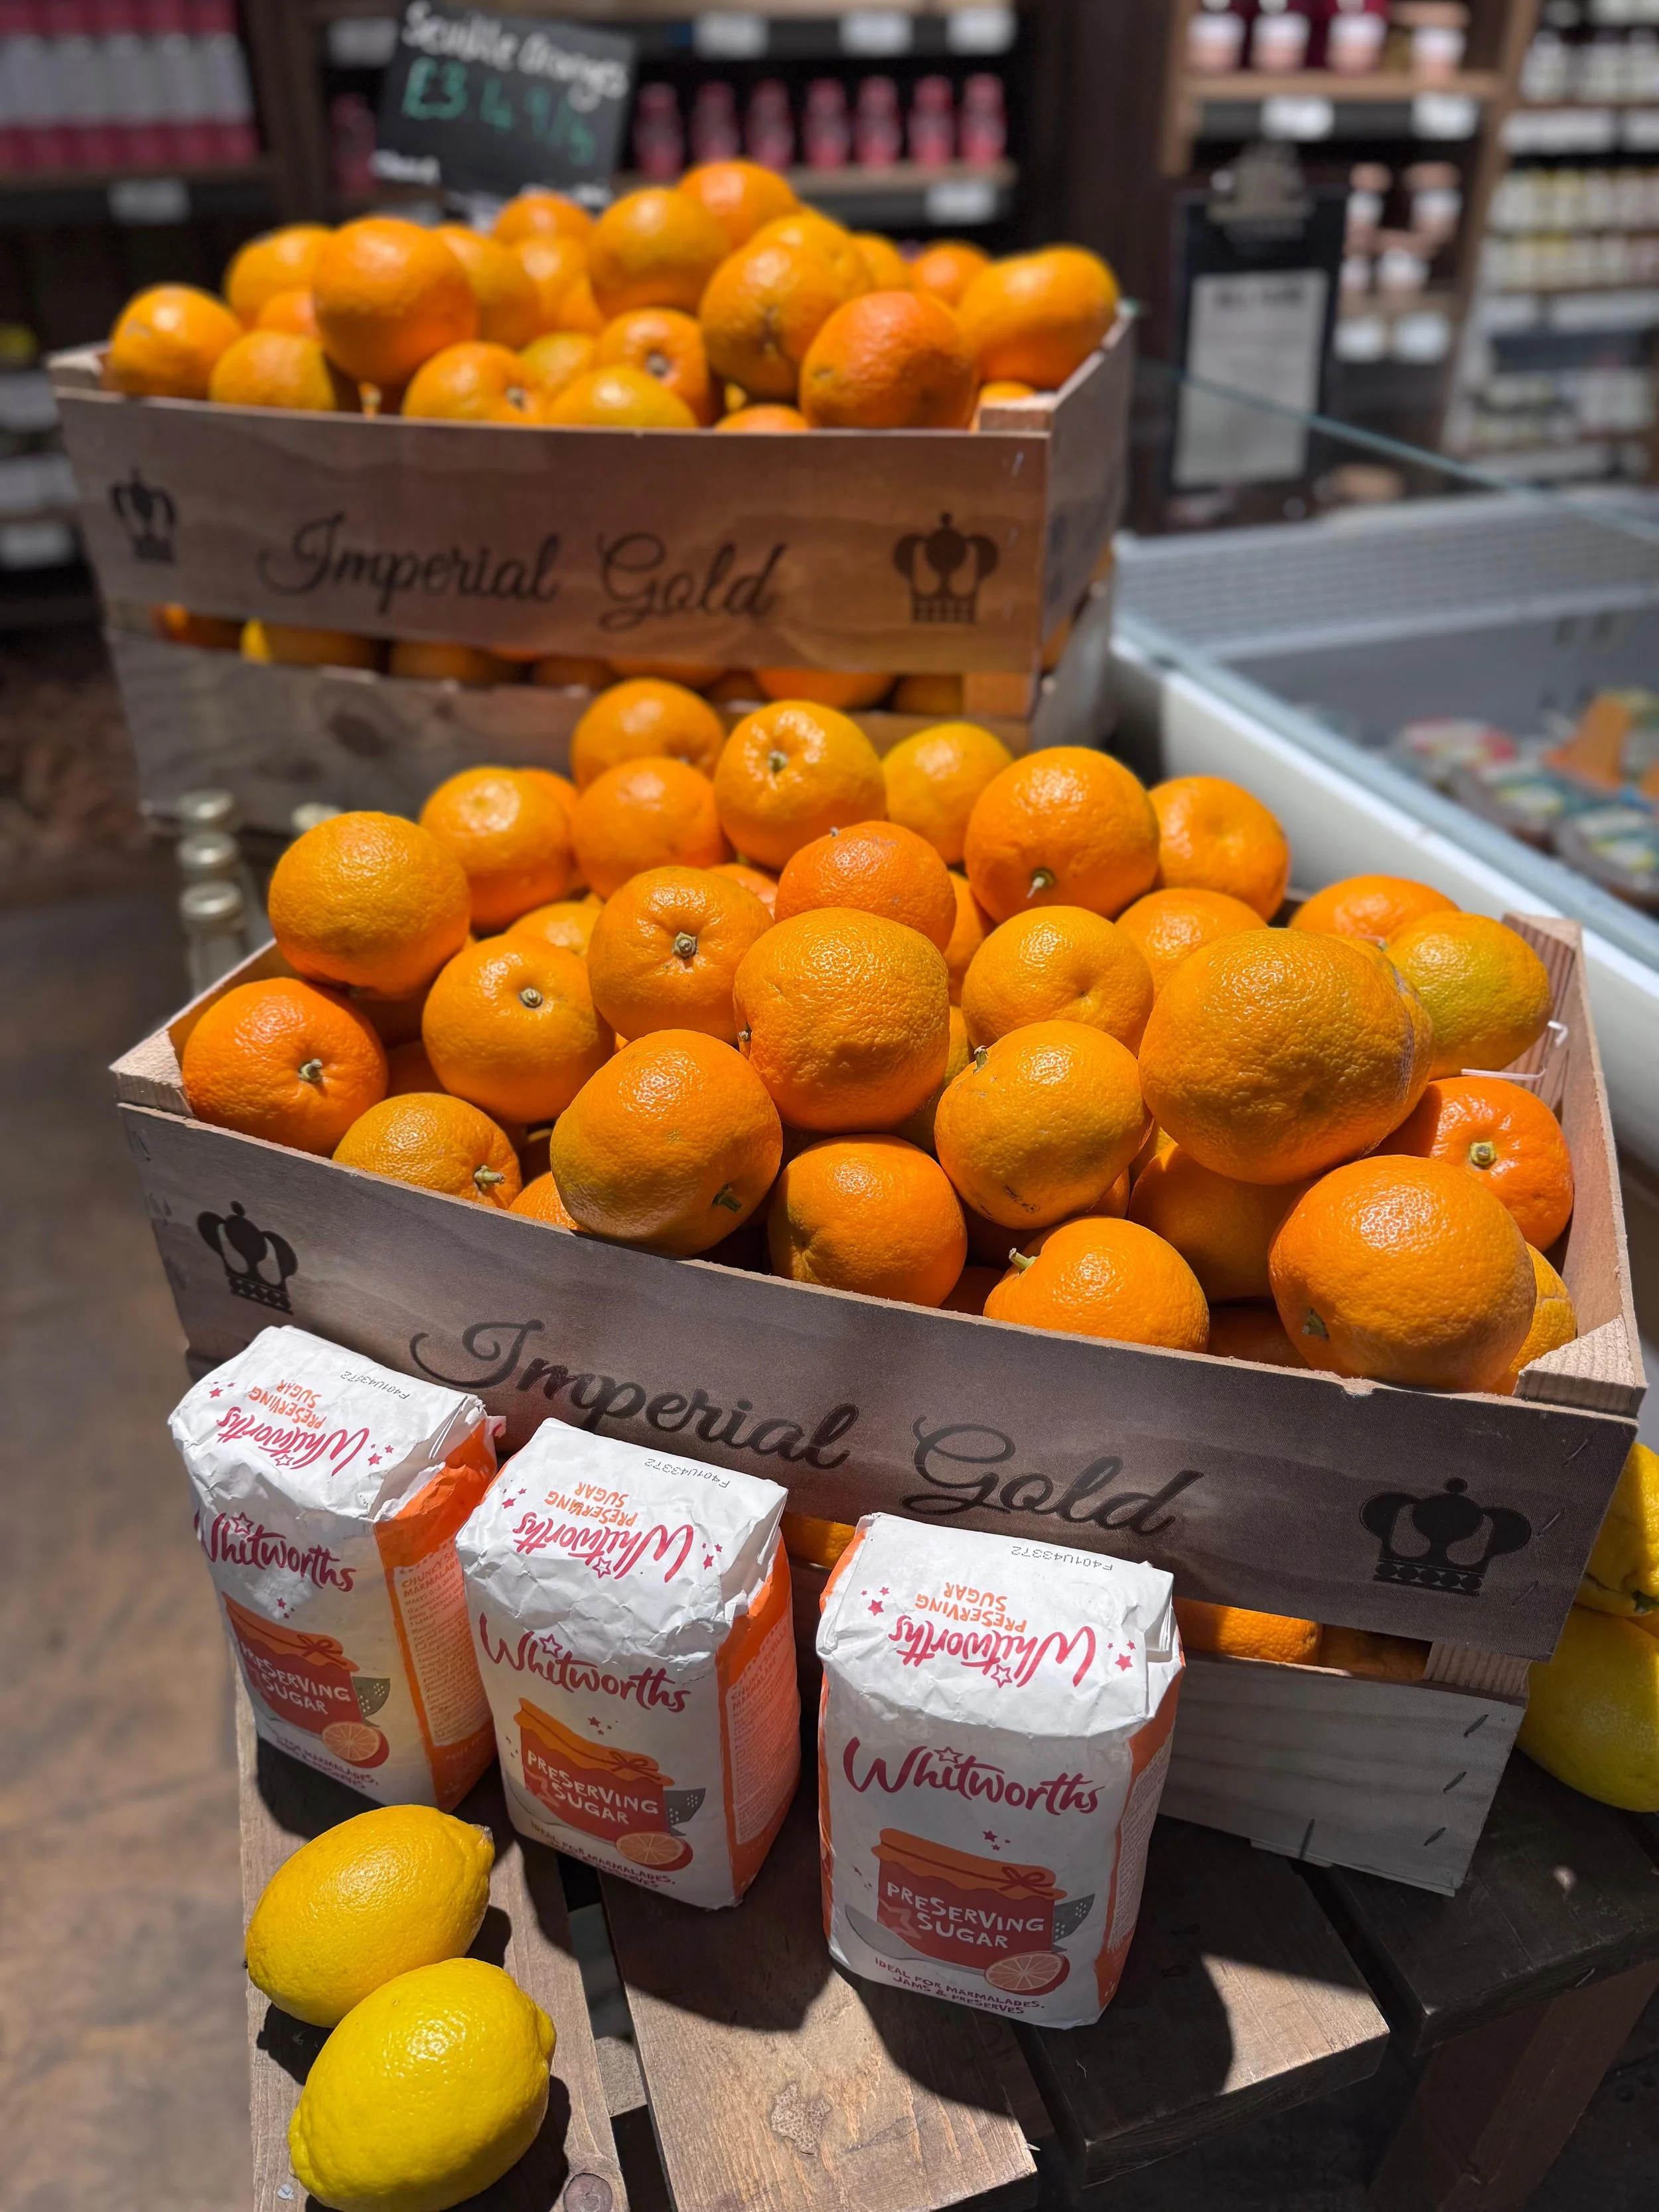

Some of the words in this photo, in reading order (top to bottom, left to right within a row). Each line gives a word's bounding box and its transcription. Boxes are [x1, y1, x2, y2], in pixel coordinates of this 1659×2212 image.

[255, 510, 562, 616] Imperial
[595, 530, 788, 632] Gold
[248, 1386, 327, 1429] PRESERVING
[277, 1379, 322, 1407] SUGAR
[216, 1406, 370, 1476] Whitworths
[409, 1319, 859, 1471] Imperial
[901, 1416, 1204, 1537] Gold
[575, 1481, 629, 1507] SUGAR
[644, 1458, 731, 1489] F401U43372
[545, 1491, 639, 1526] PRESERVING
[194, 1509, 357, 1592] Whitworths
[513, 1512, 695, 1583] Whitworths
[1011, 1545, 1114, 1572] F401U43372
[914, 1593, 1028, 1633] PRESERVING
[945, 1582, 1008, 1611] SUGAR
[240, 1641, 351, 1702] PRESERVING
[479, 1612, 691, 1713] Whitworths
[888, 1615, 1096, 1688] Whitworths
[261, 1672, 328, 1715] SUGAR
[528, 1749, 658, 1814] PRESERVING
[843, 1736, 1106, 1816] Whitworths
[551, 1782, 629, 1825] SUGAR
[887, 1881, 1045, 1932] PRESERVING
[916, 1911, 1009, 1949] SUGAR
[875, 1957, 911, 1979] IDEAL
[914, 1976, 942, 1989] FOR
[893, 1976, 932, 1992] JAMS
[952, 1994, 1025, 2014] PRESERVES
